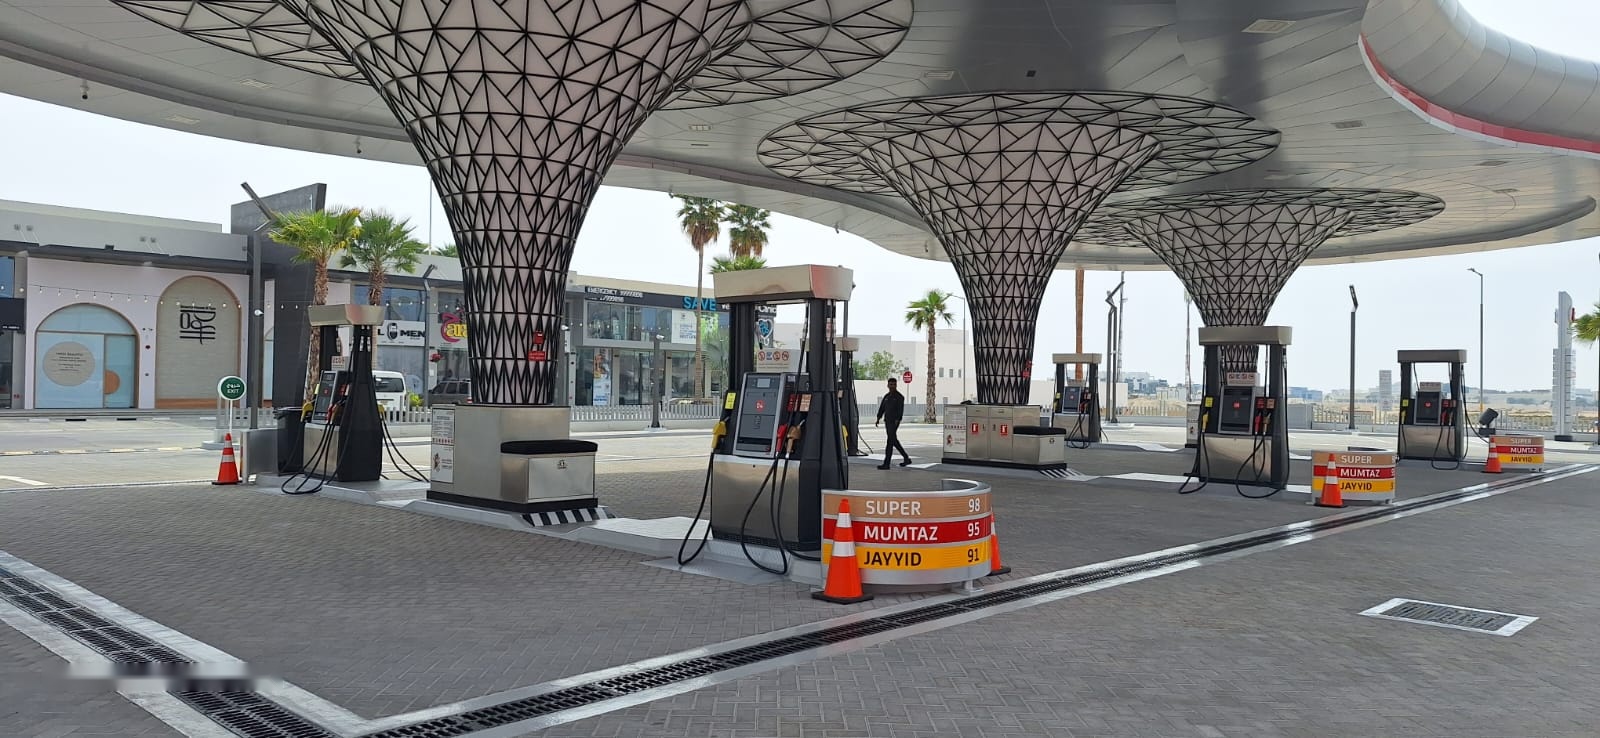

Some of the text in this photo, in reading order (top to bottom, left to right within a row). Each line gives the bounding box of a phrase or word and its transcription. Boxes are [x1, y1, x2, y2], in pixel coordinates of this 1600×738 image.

[400, 329, 425, 338] MEN
[1341, 454, 1372, 464] SUPER
[1340, 468, 1381, 478] MUMTAZ
[1340, 481, 1372, 491] JAYYID
[865, 497, 981, 516] SUPER 98
[863, 521, 980, 542] MUMTAZ 95
[863, 548, 980, 567] JAYYID 91
